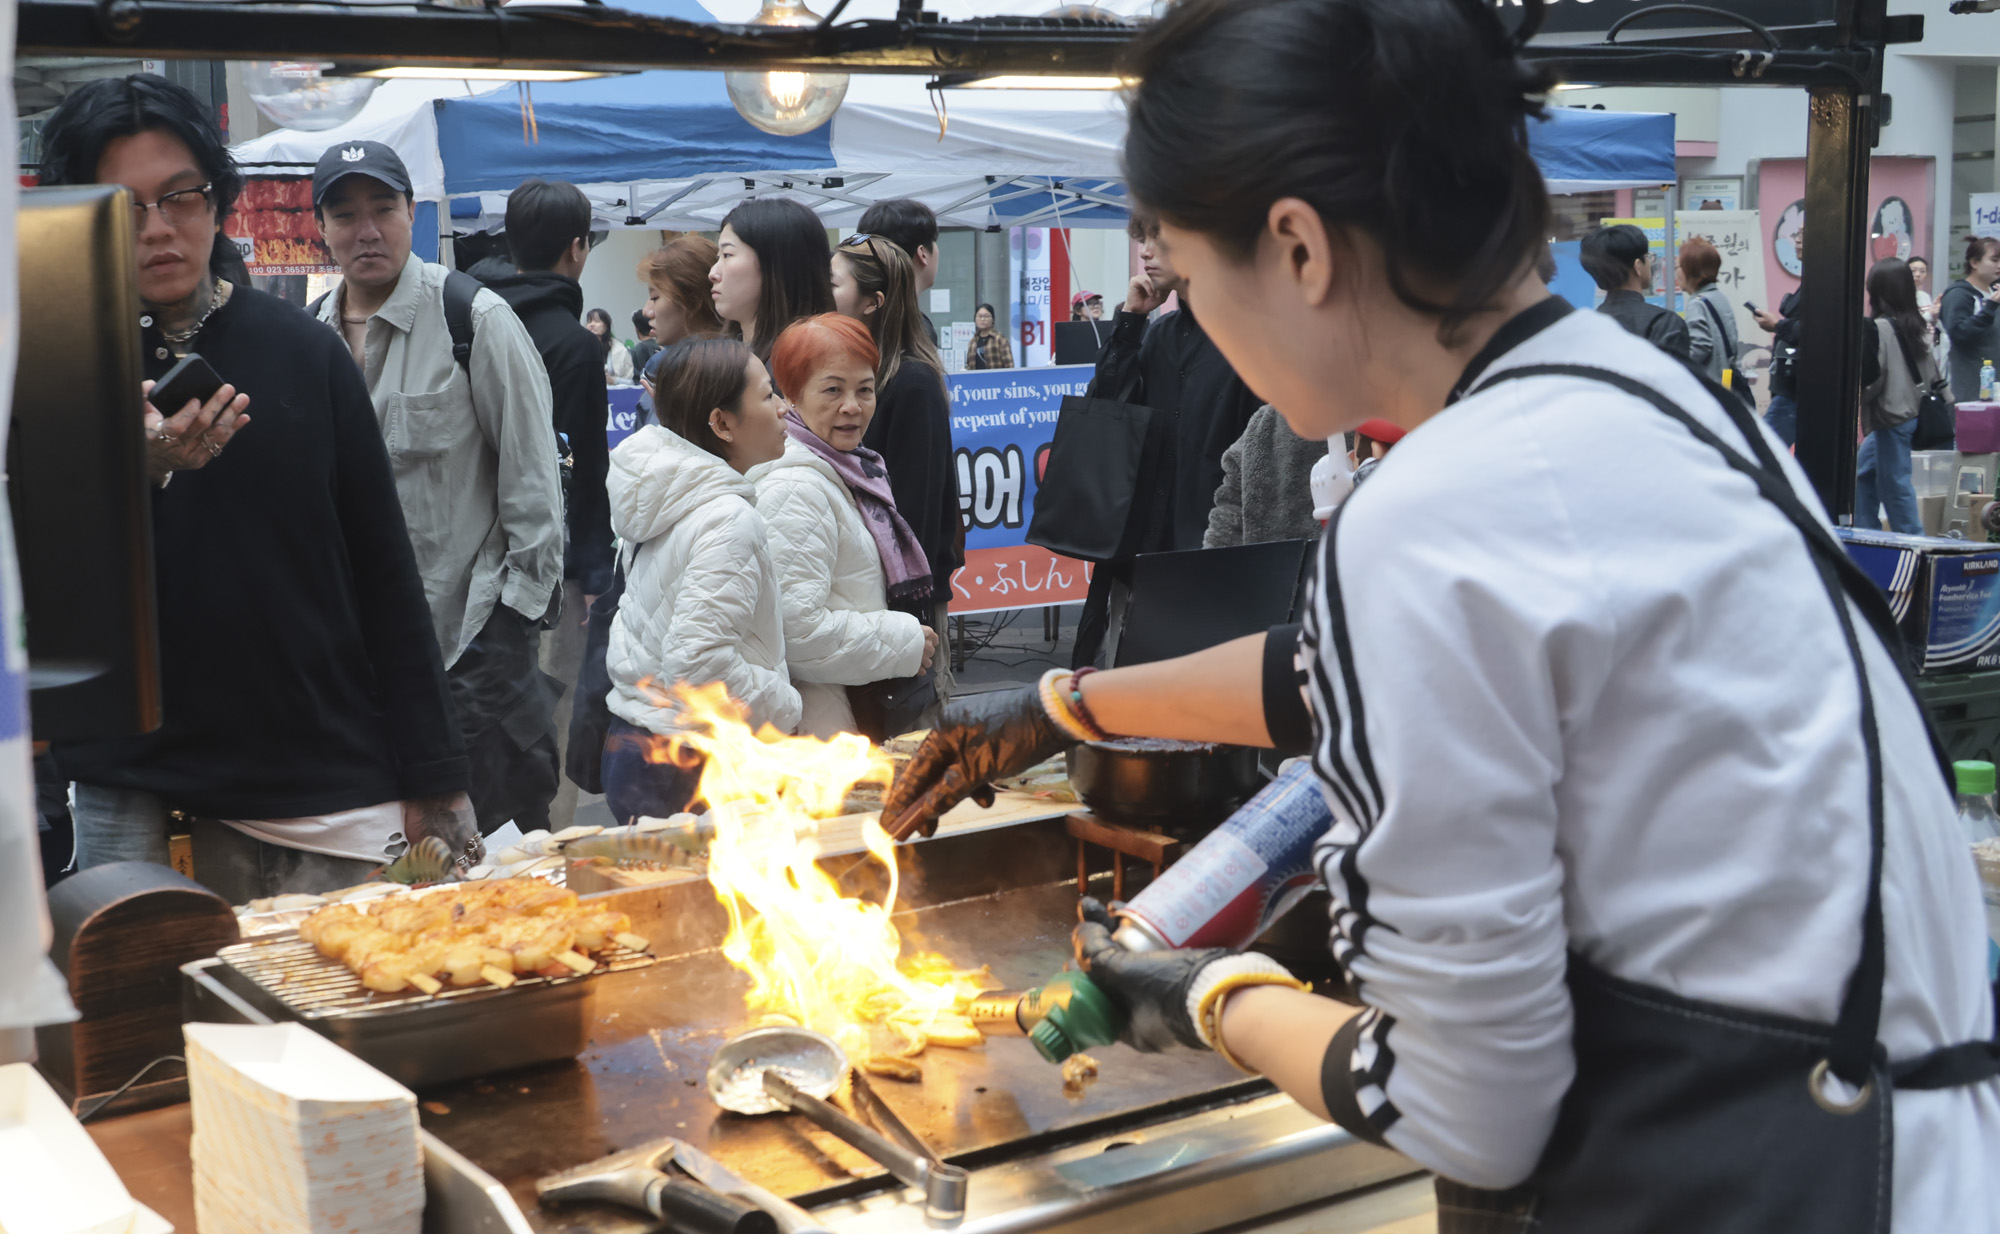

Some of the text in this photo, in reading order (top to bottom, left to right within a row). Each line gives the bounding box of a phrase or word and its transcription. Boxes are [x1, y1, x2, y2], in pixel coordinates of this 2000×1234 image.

[1021, 320, 1044, 346] B1
[962, 387, 1001, 407] your
[1004, 381, 1041, 399] sins,
[1042, 383, 1071, 401] you
[953, 410, 1007, 432] repent
[1009, 407, 1028, 425] of
[1963, 560, 1998, 570] KIRKLAND
